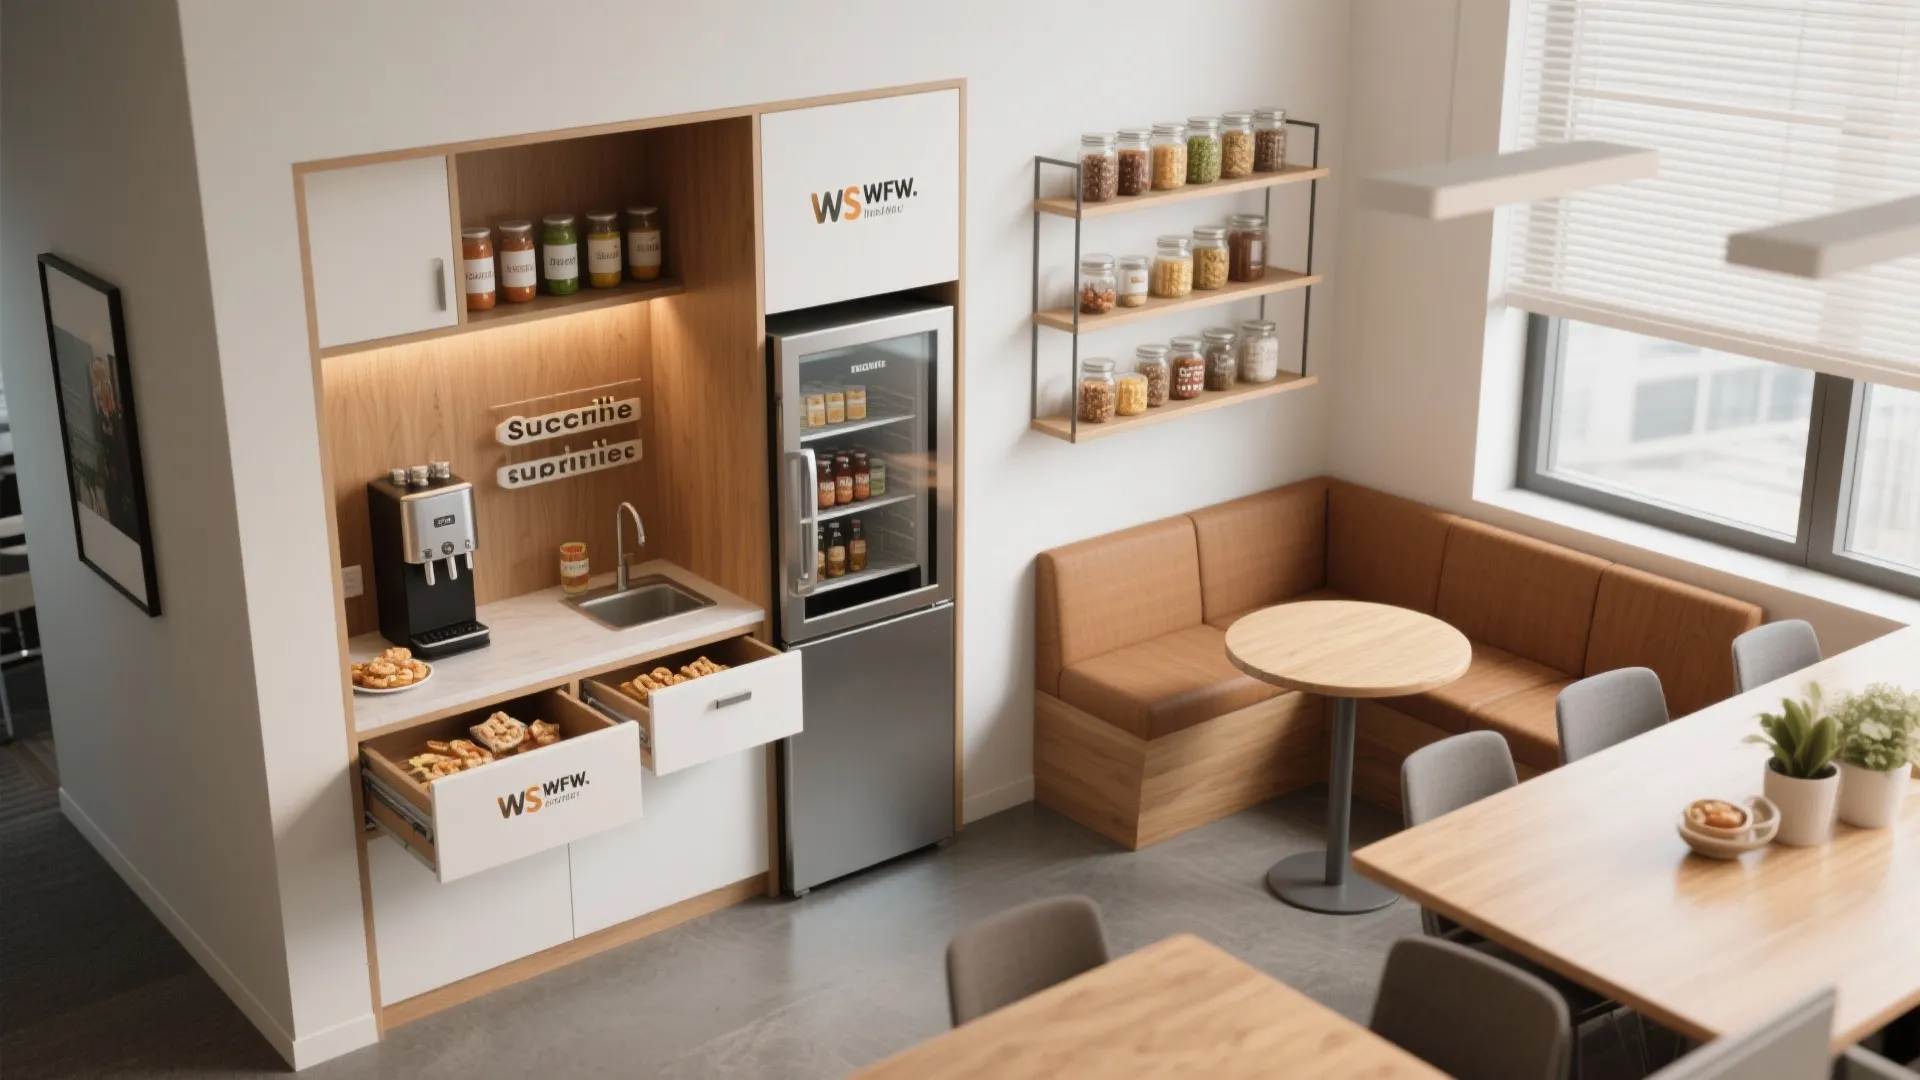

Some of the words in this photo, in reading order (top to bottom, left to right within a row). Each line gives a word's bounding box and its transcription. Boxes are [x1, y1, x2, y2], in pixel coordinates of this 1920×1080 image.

[811, 185, 861, 224] WS
[863, 177, 917, 204] WFW.
[498, 785, 542, 819] WS
[543, 770, 590, 797] WFW.
